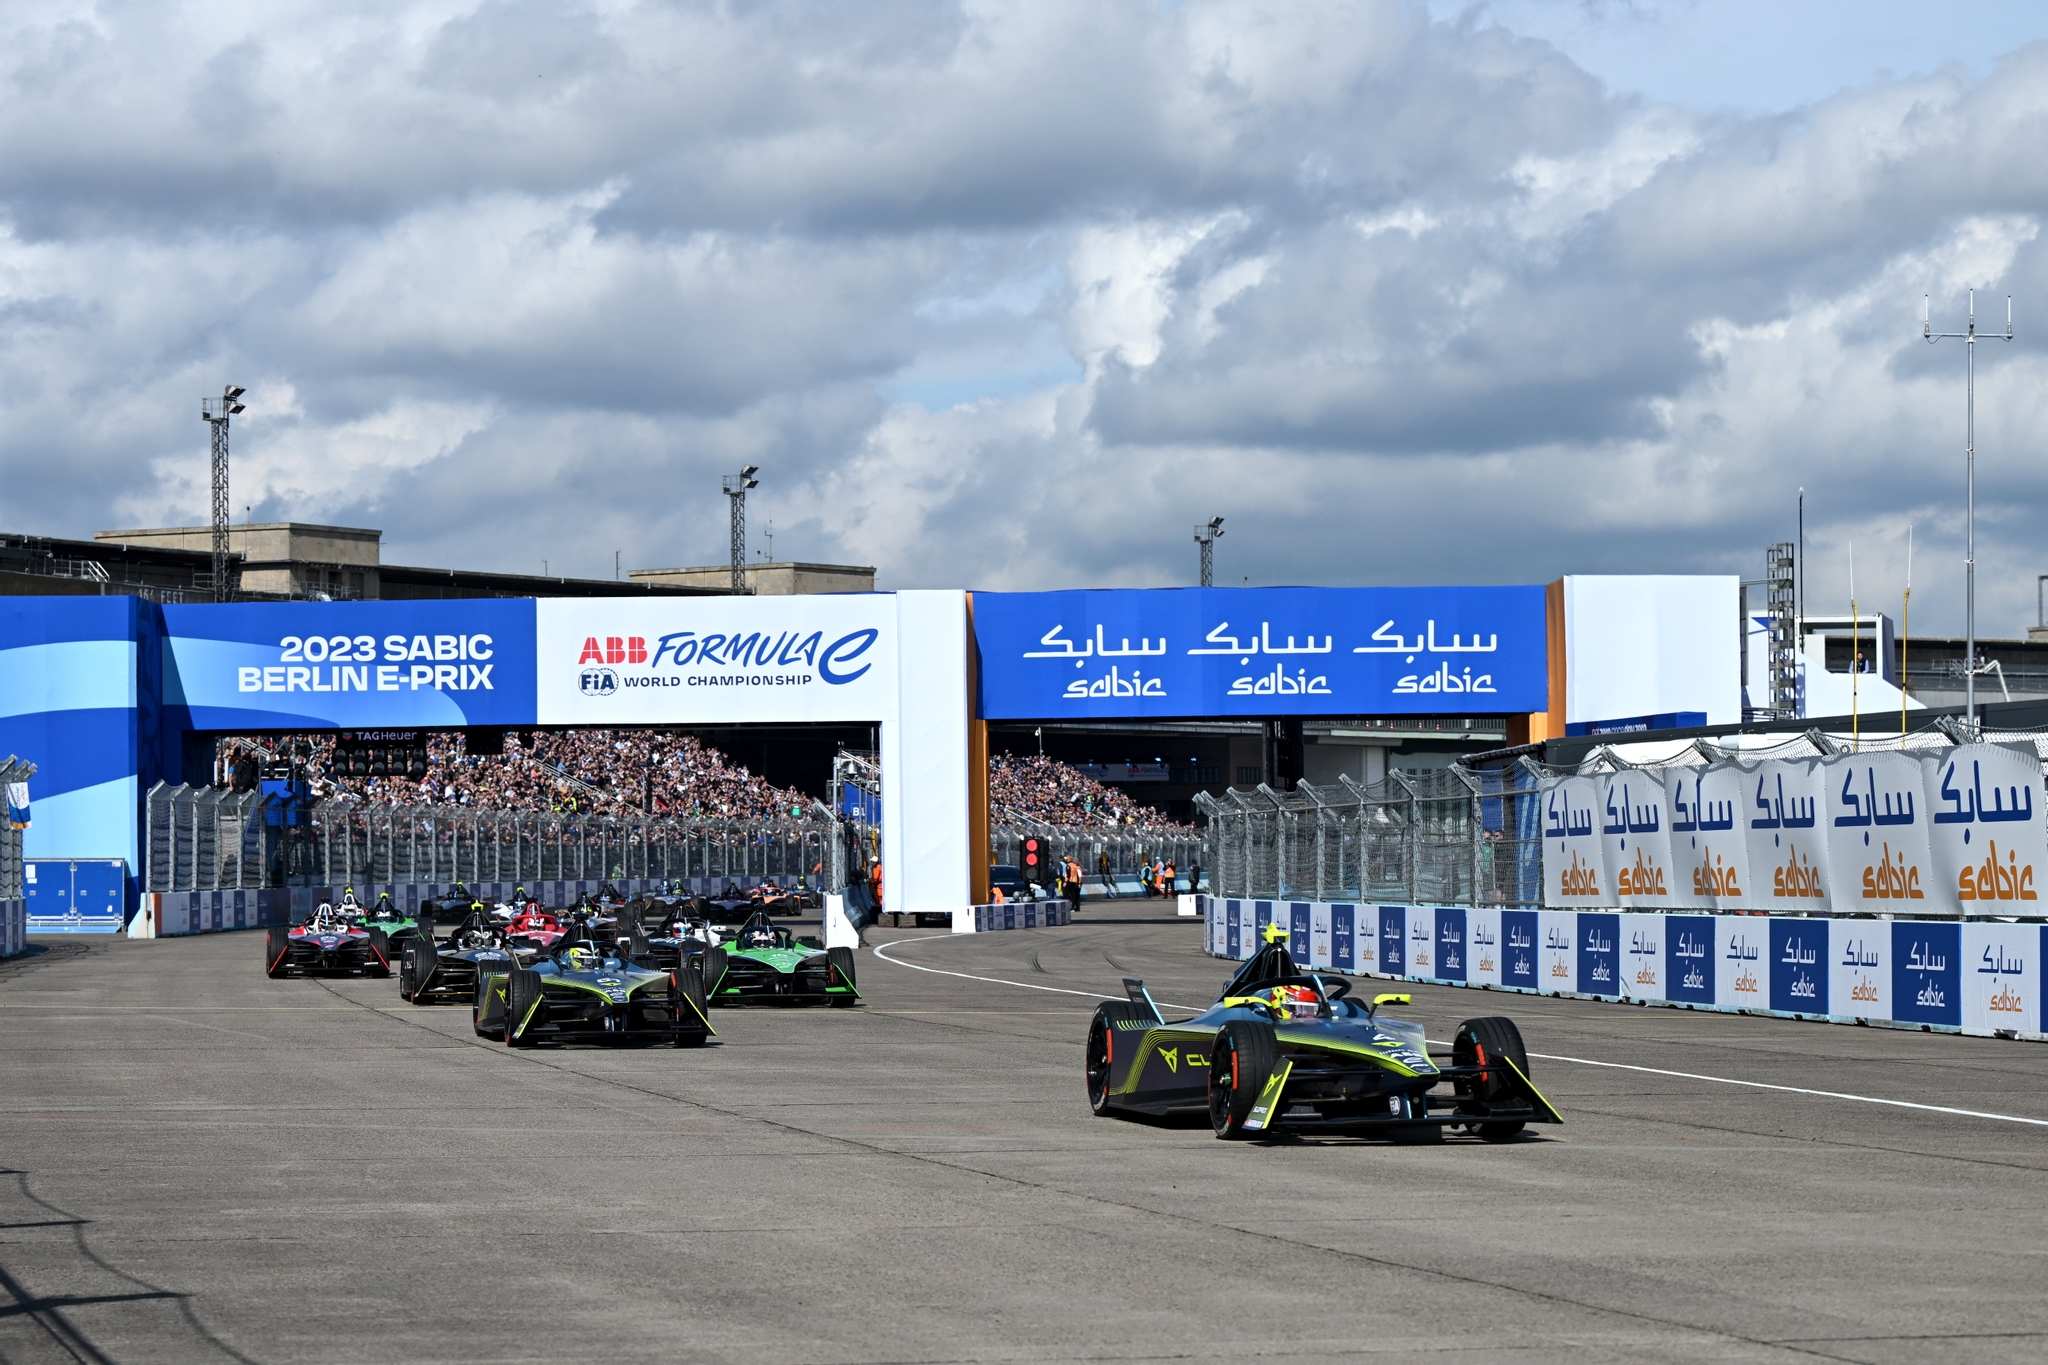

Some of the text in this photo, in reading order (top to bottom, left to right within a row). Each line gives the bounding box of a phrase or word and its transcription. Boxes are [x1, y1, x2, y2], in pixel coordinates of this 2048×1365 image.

[281, 635, 492, 662] 2023 SABIC
[579, 637, 648, 664] ABB
[652, 630, 823, 668] FORMULA
[239, 665, 493, 692] BERLIN E-PRIX
[624, 675, 811, 687] WORLD CHAMPIONSHIP
[1063, 664, 1166, 697] sabic
[1228, 662, 1331, 694] sabic
[1393, 660, 1496, 692] sabic
[1562, 850, 1599, 896] sabic
[1618, 847, 1667, 896] sabic
[1693, 846, 1741, 897] sabic
[1773, 844, 1823, 897] sabic
[1863, 842, 1924, 899] sabic
[1958, 840, 2037, 900] sabic
[1735, 966, 1757, 992] sabic
[1791, 972, 1815, 997] sabic
[1852, 974, 1878, 1002] sabic
[1917, 978, 1945, 1007] sabic
[1990, 983, 2022, 1012] sabic
